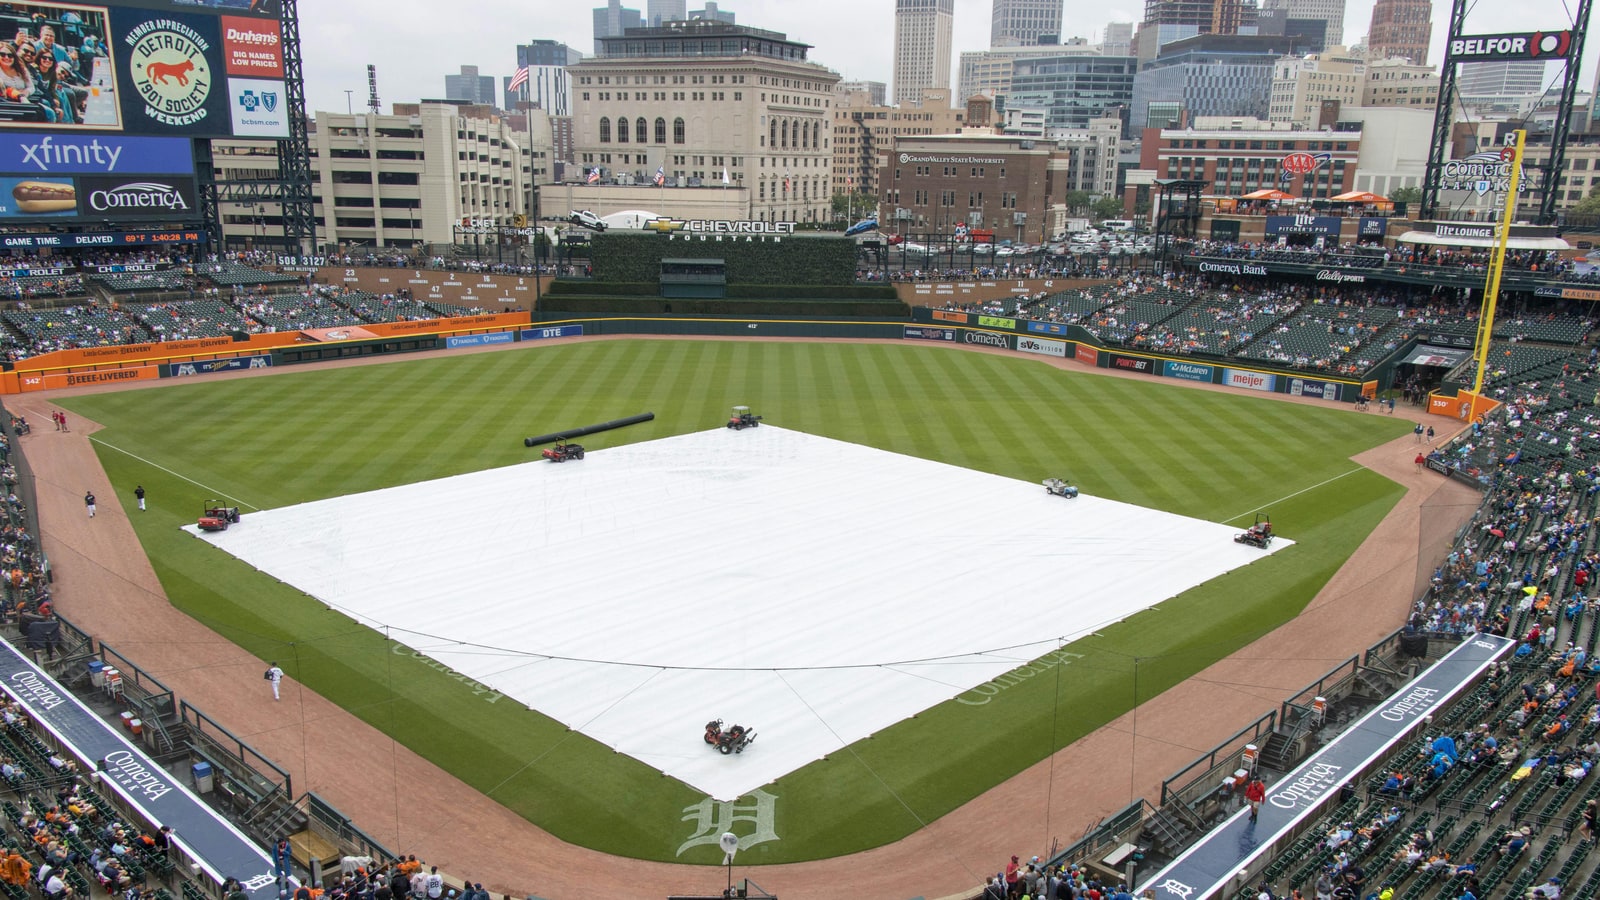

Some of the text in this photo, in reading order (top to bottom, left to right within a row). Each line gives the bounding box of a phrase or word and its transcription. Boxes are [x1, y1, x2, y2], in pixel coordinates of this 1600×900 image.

[125, 19, 210, 52] MEMBER APPRECIATION
[227, 28, 278, 43] Dunham's
[138, 35, 199, 59] DETROIT
[1451, 38, 1526, 55] BELFOR
[249, 52, 275, 60] NAMES
[250, 60, 278, 68] PRICES
[138, 79, 207, 112] 1901 SOCIETY
[145, 104, 208, 126] WEEKEND
[20, 136, 122, 171] xfinity
[968, 156, 1005, 164] UNIVERSITY
[1295, 214, 1315, 227] Lite
[689, 221, 797, 234] CHEVROLET
[1436, 225, 1491, 238] Lite LOUNGE
[5, 237, 32, 246] GAME
[36, 236, 61, 245] TIME:
[76, 235, 113, 244] DELAYED
[152, 233, 181, 242] 1:40:28
[185, 233, 198, 241] PM
[670, 235, 781, 243] FOUNTAIN
[279, 256, 325, 267] 508 3127
[0, 268, 64, 278] CHEVROLET
[98, 264, 156, 273] CHEVROLET
[345, 269, 355, 277] 23
[1243, 266, 1267, 275] Bank
[1316, 270, 1365, 283] Bally SPORTS
[431, 285, 440, 293] 47
[1044, 280, 1054, 288] 42
[543, 328, 561, 338] DTE
[1041, 345, 1062, 353] VISION
[1116, 358, 1147, 370] POINTSBET
[1179, 365, 1208, 375] McLaren
[1233, 374, 1264, 387] meijer
[1304, 385, 1323, 394] Modelo
[108, 767, 140, 792] PARK
